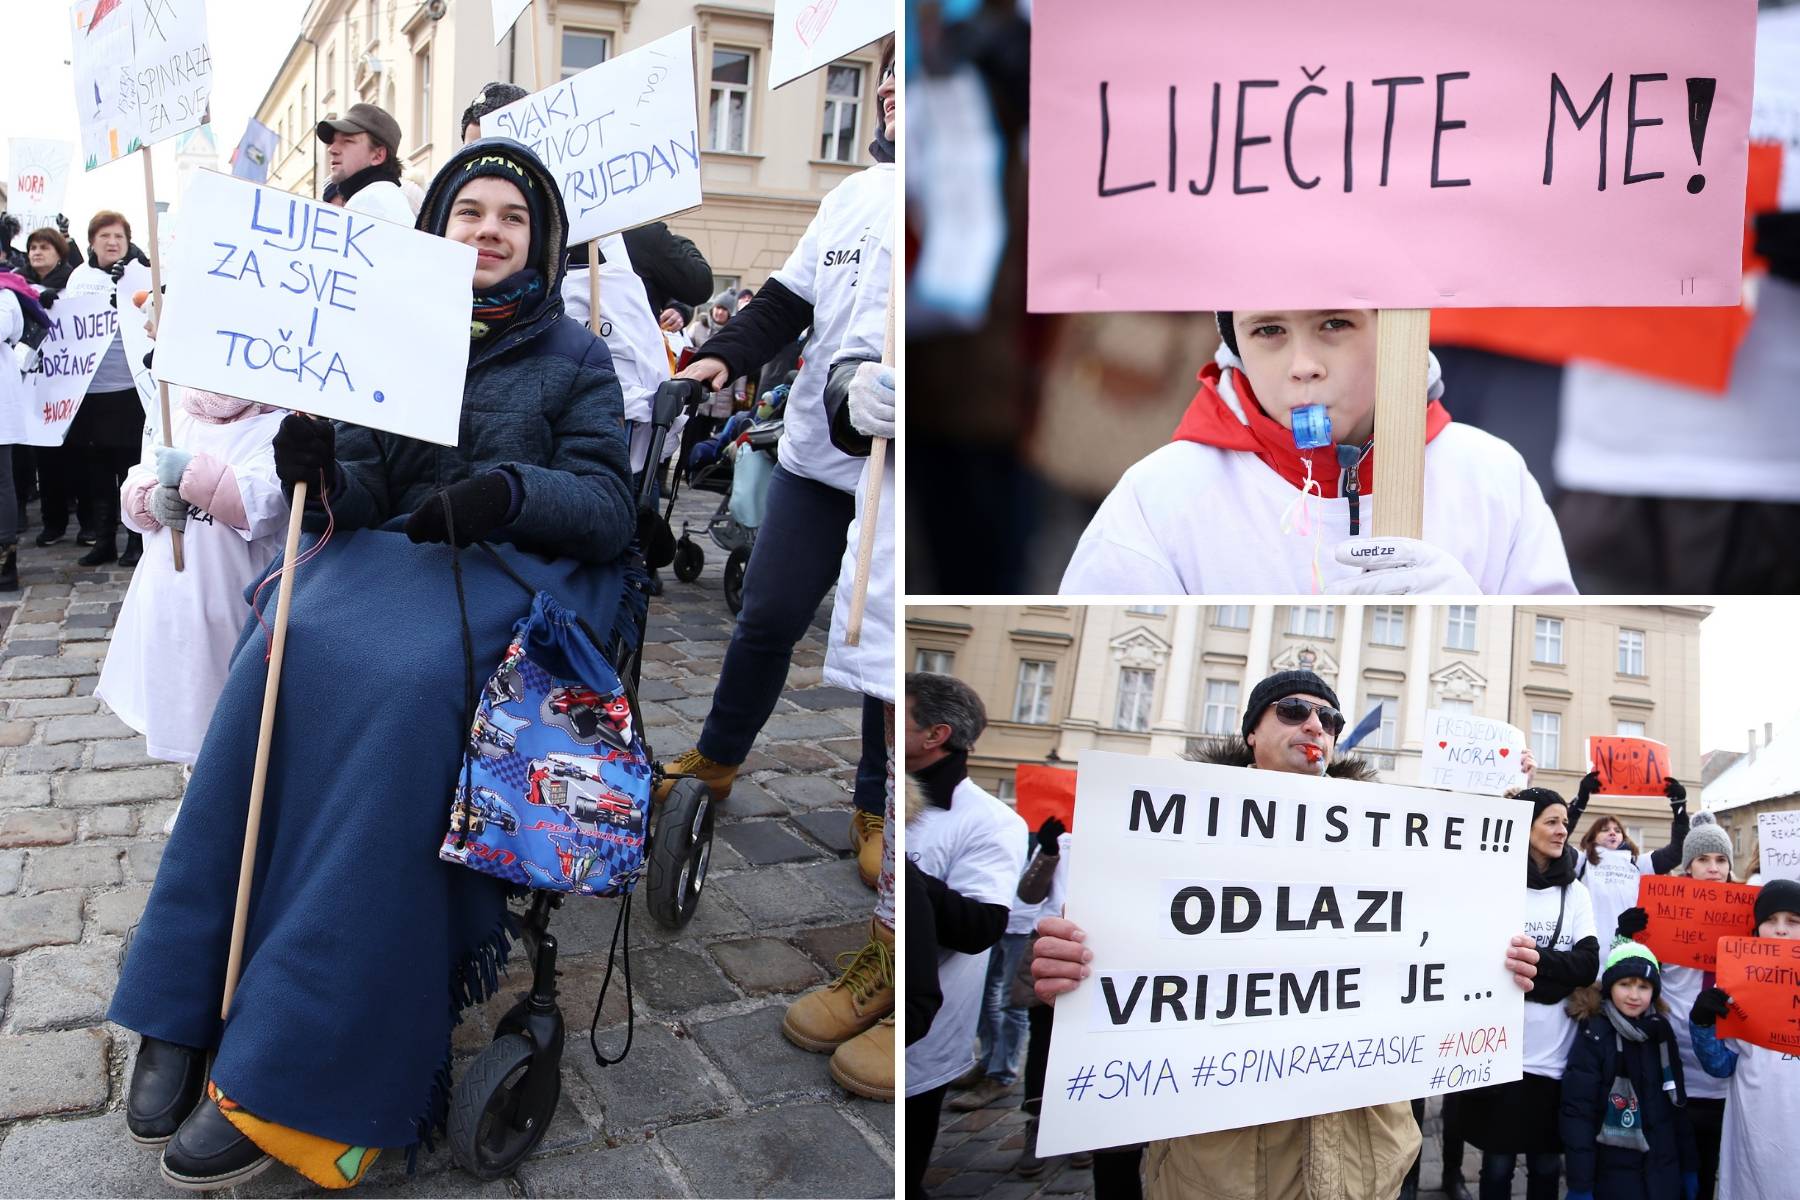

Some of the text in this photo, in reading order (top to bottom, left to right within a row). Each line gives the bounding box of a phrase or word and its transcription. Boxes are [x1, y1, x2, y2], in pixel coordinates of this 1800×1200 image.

[137, 43, 213, 105] SPINRAZA
[149, 104, 171, 133] ZA
[175, 86, 205, 121] SVE
[497, 82, 579, 139] SVAKI
[1099, 65, 1717, 197] LIJEČITE ME!
[18, 175, 45, 194] NORA
[251, 188, 375, 267] LIJEK
[207, 242, 358, 312] ZA SVE
[823, 249, 861, 267] SMA
[73, 310, 118, 340] DIJETE
[308, 307, 318, 348] I
[44, 347, 97, 377] DRŽAVE
[1448, 747, 1496, 767] NORA
[1693, 887, 1717, 901] VAS
[1100, 967, 1361, 1026] VRIJEME
[1066, 1025, 1508, 1101] #SMA #SPINRAZAZASVE #NORA
[1429, 1058, 1493, 1090] #Omiš
